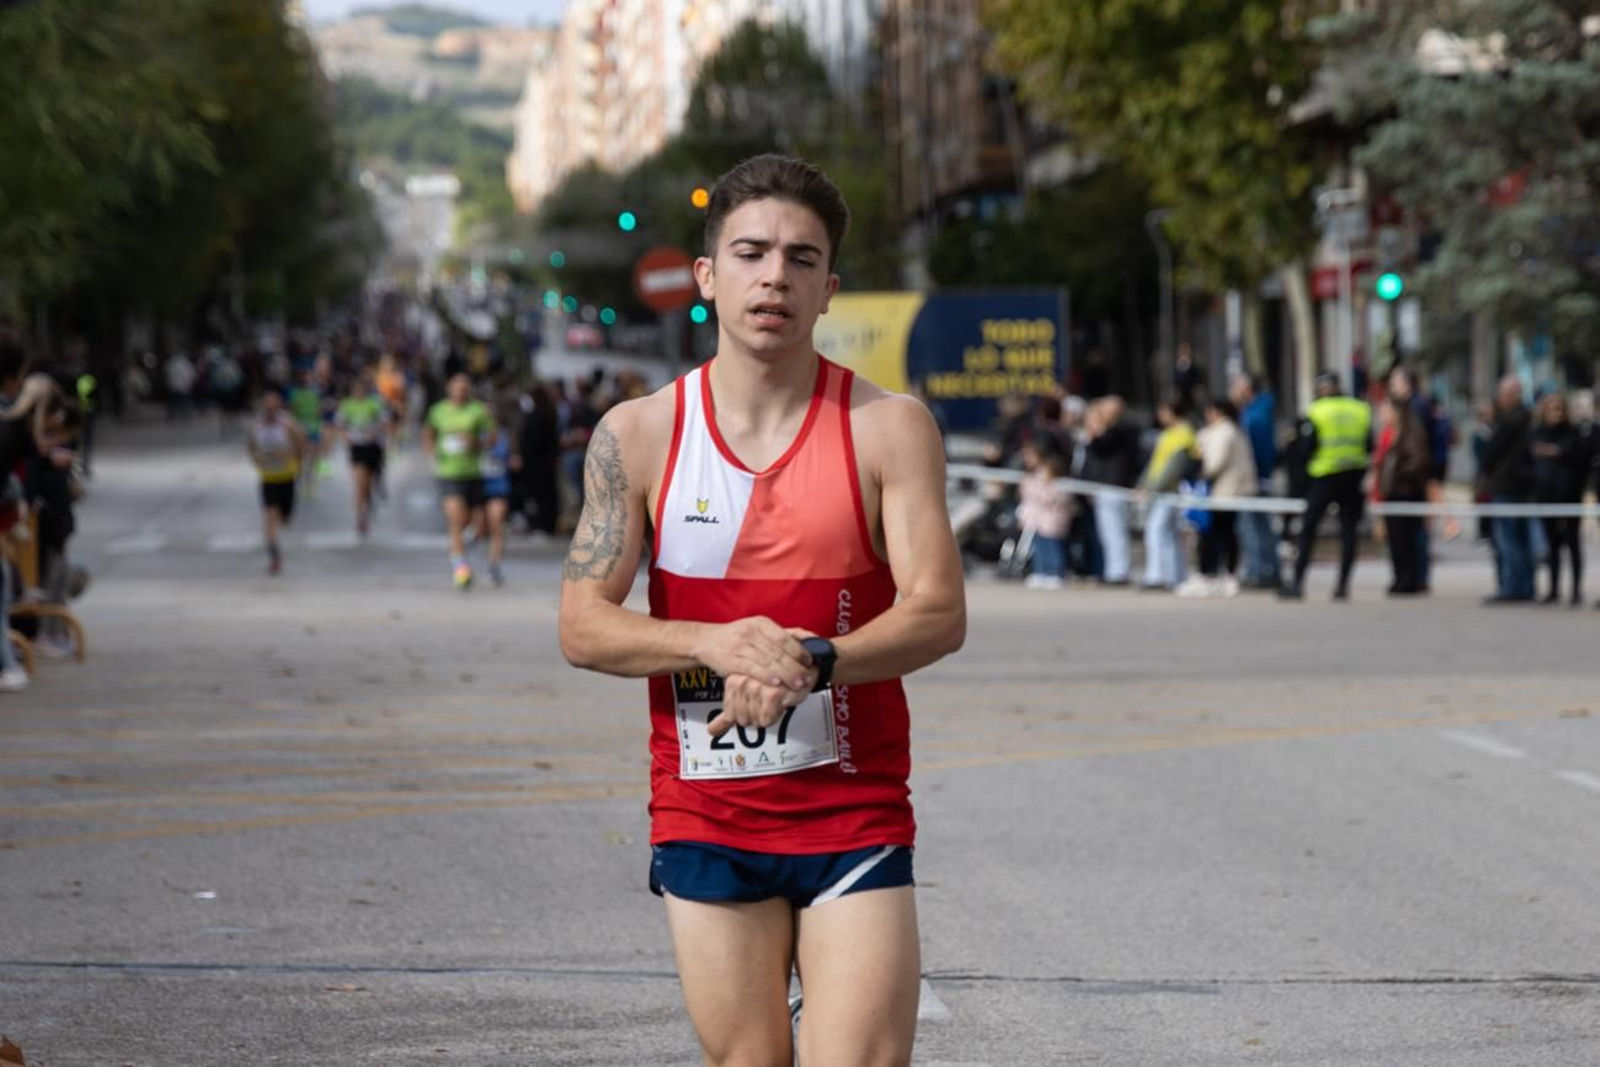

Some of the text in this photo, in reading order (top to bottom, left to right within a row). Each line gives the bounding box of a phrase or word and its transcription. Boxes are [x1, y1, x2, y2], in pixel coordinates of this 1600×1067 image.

[981, 318, 1056, 342] TODO
[963, 345, 999, 370] LO
[683, 514, 719, 524] SPALL
[836, 589, 852, 634] CLUB
